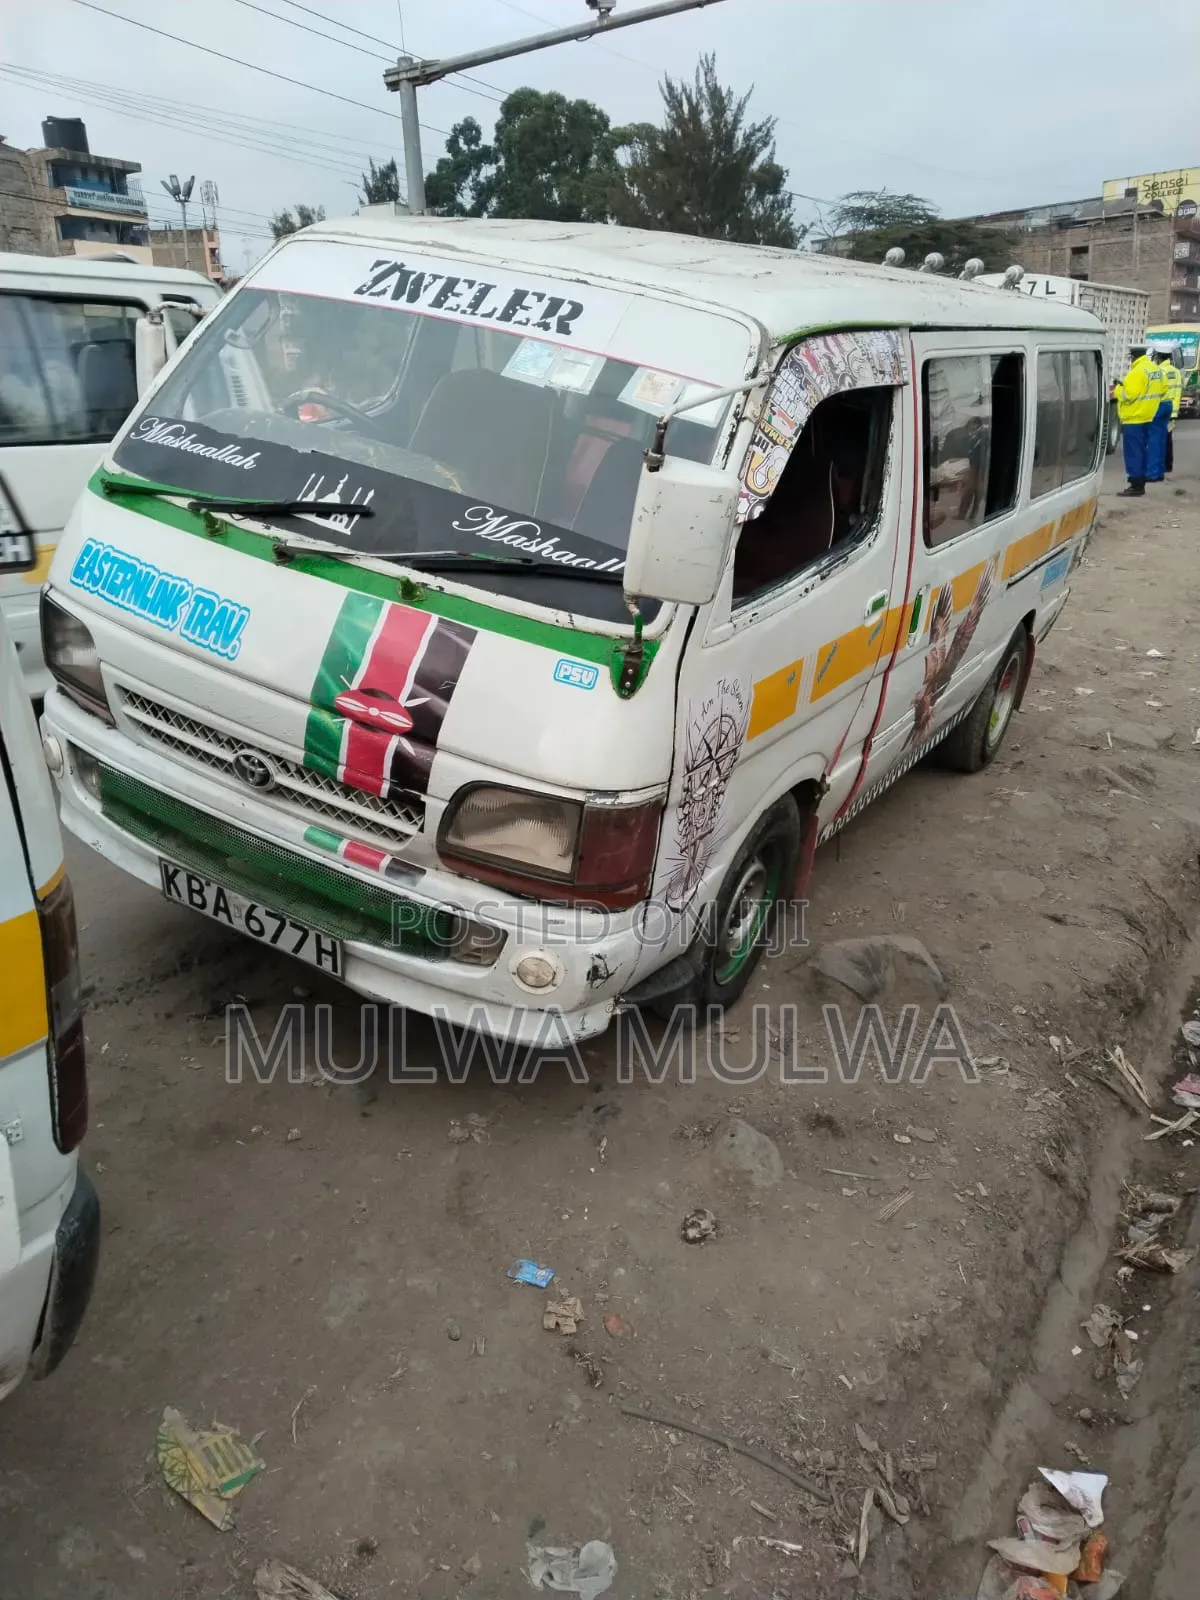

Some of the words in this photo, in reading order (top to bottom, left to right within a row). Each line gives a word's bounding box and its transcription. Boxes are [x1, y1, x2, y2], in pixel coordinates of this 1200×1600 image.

[1143, 173, 1189, 191] Sensei
[1145, 188, 1184, 199] COLLEGE
[353, 259, 584, 335] ZWELER
[130, 417, 261, 470] Mashaallah
[452, 506, 626, 572] Mashaall
[70, 539, 192, 630] EASTERNLINK
[180, 588, 250, 659] TRAV.
[559, 663, 594, 686] PSV
[163, 863, 234, 924] KBA
[245, 904, 338, 973] 677H
